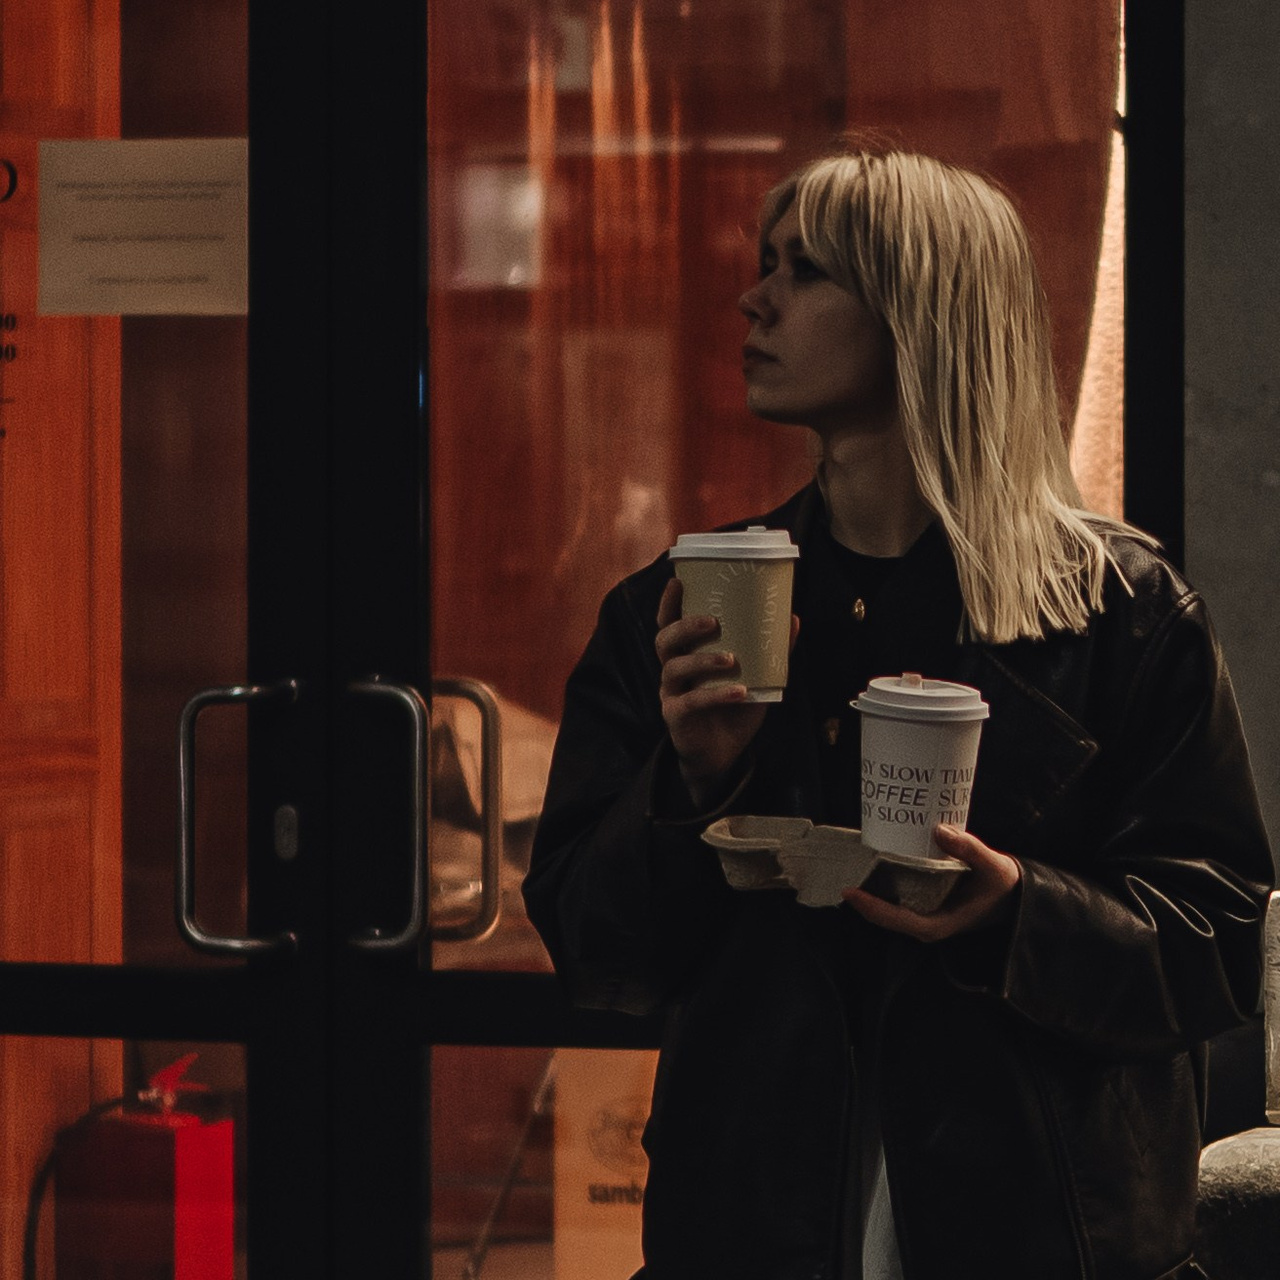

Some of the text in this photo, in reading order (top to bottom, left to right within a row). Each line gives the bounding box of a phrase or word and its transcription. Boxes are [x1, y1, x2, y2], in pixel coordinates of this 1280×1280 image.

[880, 763, 934, 783] SLOW
[861, 777, 929, 806] OFFEE
[877, 806, 929, 825] SLOW
